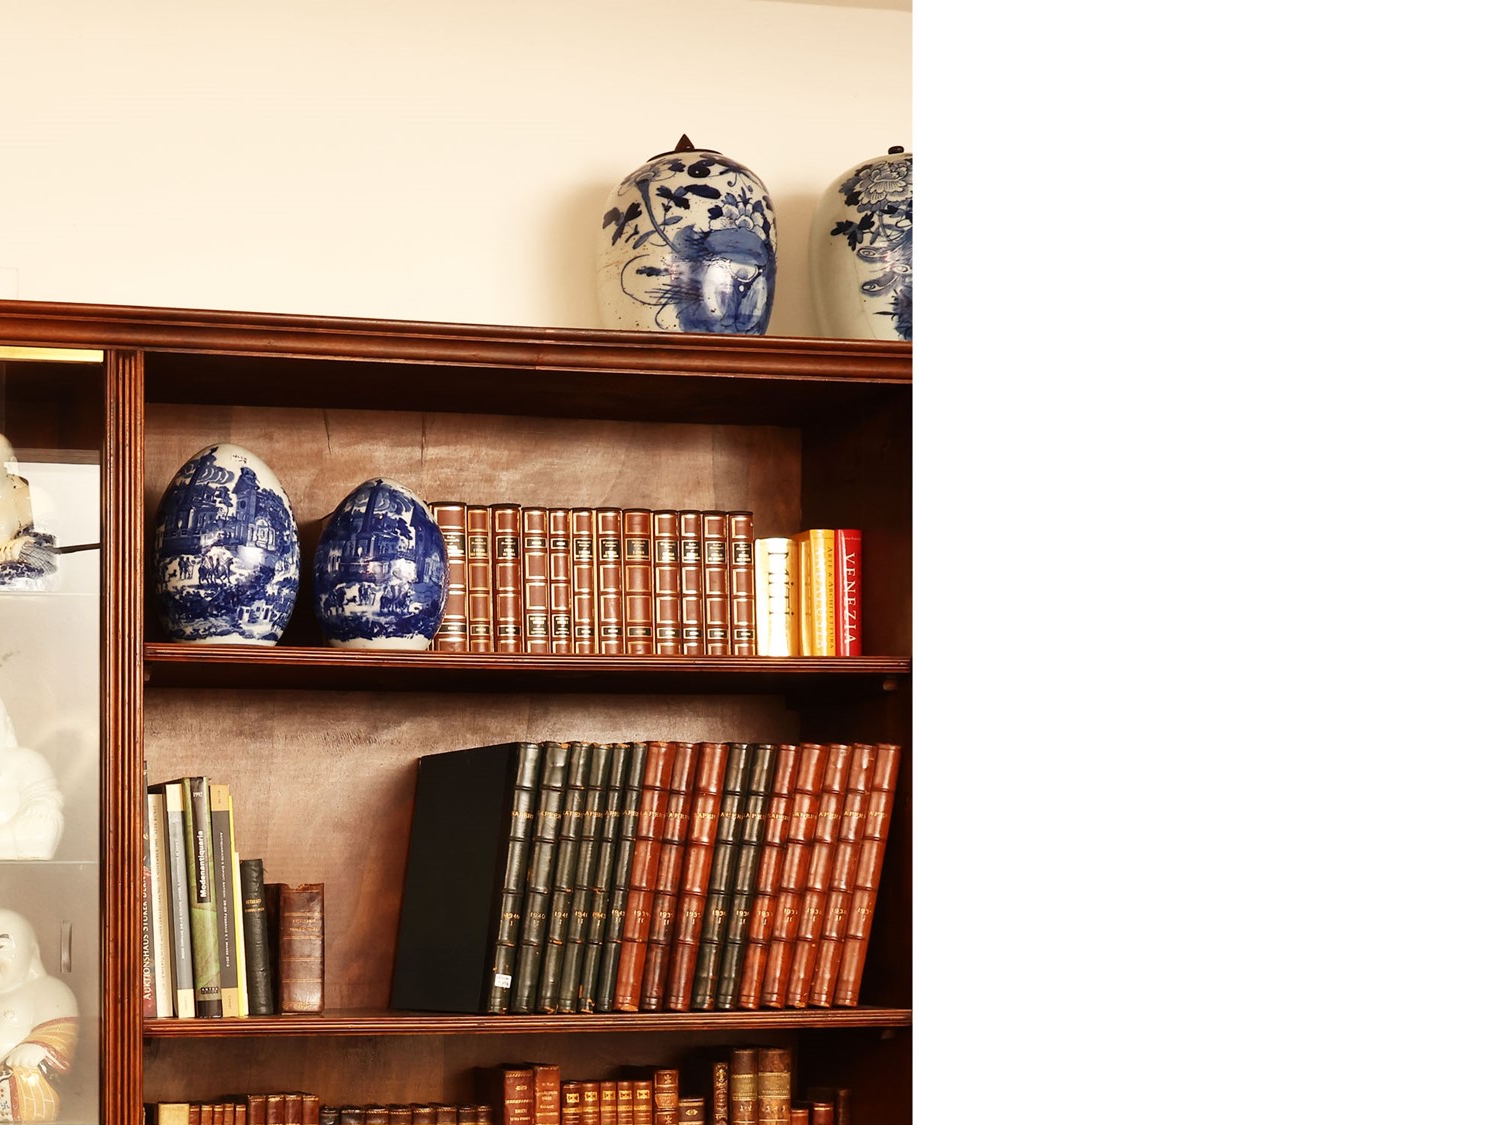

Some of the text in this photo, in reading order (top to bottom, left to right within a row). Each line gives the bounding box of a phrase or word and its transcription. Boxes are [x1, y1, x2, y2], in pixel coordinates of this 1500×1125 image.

[844, 553, 857, 643] VENEZIA
[198, 831, 206, 898] Modenantiquaria
[143, 934, 151, 1000] AUKTIONSHAUS
